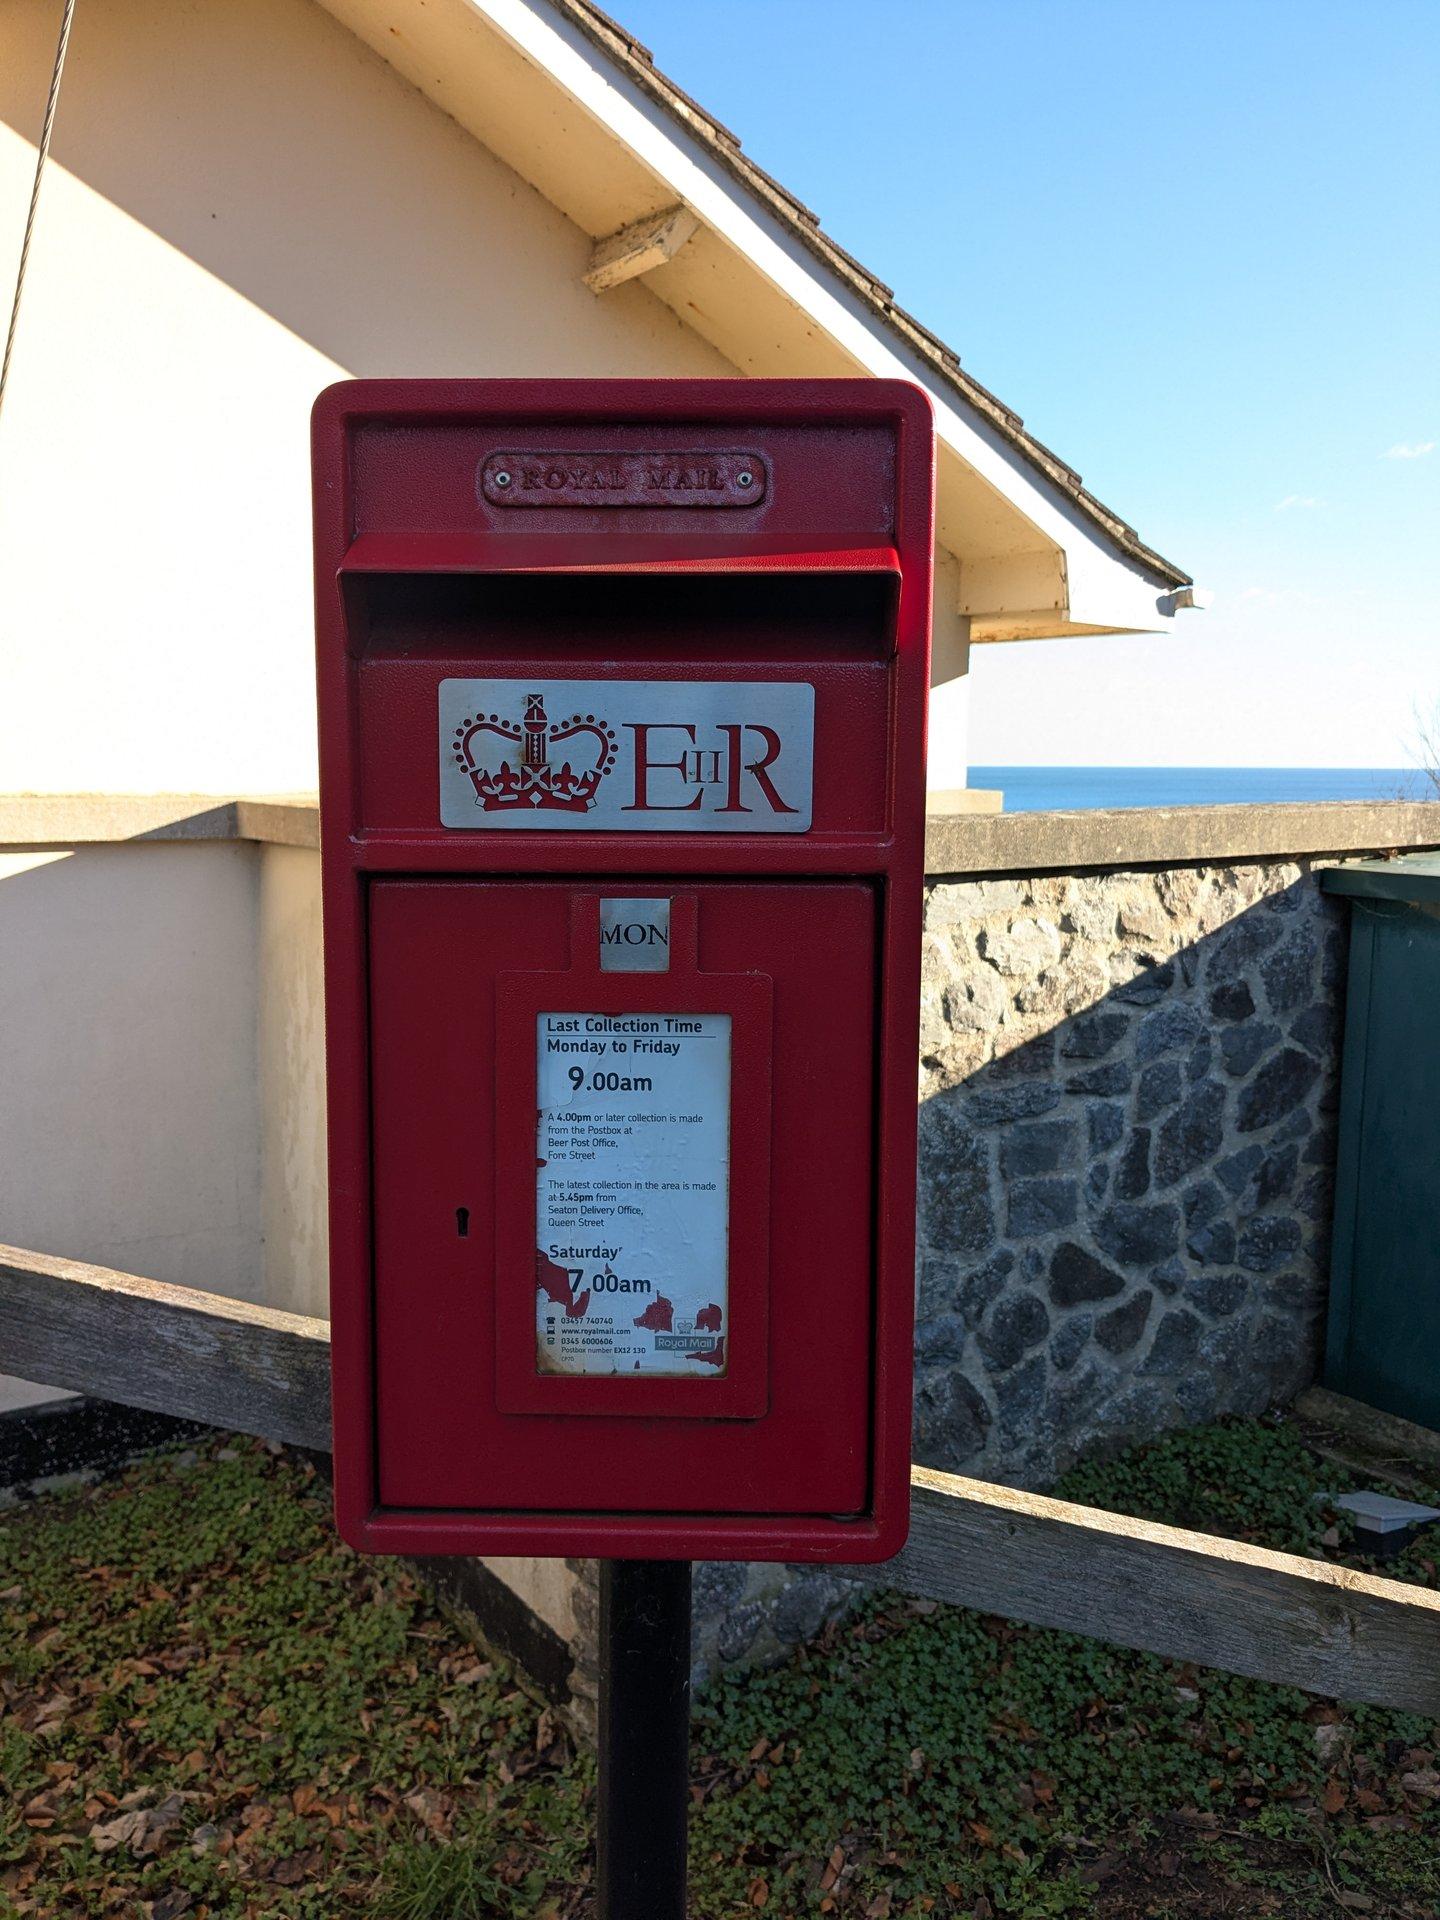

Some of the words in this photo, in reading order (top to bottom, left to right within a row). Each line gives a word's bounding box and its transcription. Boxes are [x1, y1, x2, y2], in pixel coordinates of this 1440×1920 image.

[521, 468, 628, 490] ROYAL
[647, 468, 725, 490] MAIL
[600, 924, 668, 946] MON
[547, 1018, 579, 1032] Last
[585, 1019, 659, 1032] Collection
[664, 1019, 702, 1033] Time
[547, 1039, 606, 1055] Monday
[612, 1041, 627, 1052] to
[633, 1040, 680, 1056] Friday
[568, 1066, 653, 1091] 9.00am
[557, 1114, 591, 1123] 4.00pm
[605, 1114, 625, 1122] later
[627, 1114, 667, 1122] collection
[670, 1115, 677, 1123] is
[679, 1115, 703, 1123] made
[548, 1126, 569, 1134] from
[588, 1127, 621, 1135] Postbox
[624, 1127, 632, 1135] at
[548, 1139, 568, 1147] Beer
[571, 1139, 590, 1147] Post
[592, 1139, 618, 1148] Office,
[548, 1151, 567, 1159] Fore
[569, 1152, 595, 1160] Street
[548, 1180, 565, 1189] The
[567, 1180, 590, 1189] latest
[593, 1181, 631, 1189] collection
[634, 1181, 643, 1189] in
[645, 1181, 659, 1190] the
[682, 1182, 690, 1190] is
[692, 1182, 716, 1191] made
[559, 1193, 593, 1203] 5.45pm
[548, 1206, 578, 1214] Seaton
[580, 1206, 615, 1216] Delivery
[617, 1206, 644, 1215] Office,
[548, 1218, 575, 1227] Queen
[578, 1218, 604, 1227] Street
[568, 1269, 651, 1293] 7.00am
[658, 1338, 687, 1349] Royal
[690, 1338, 712, 1347] Mail
